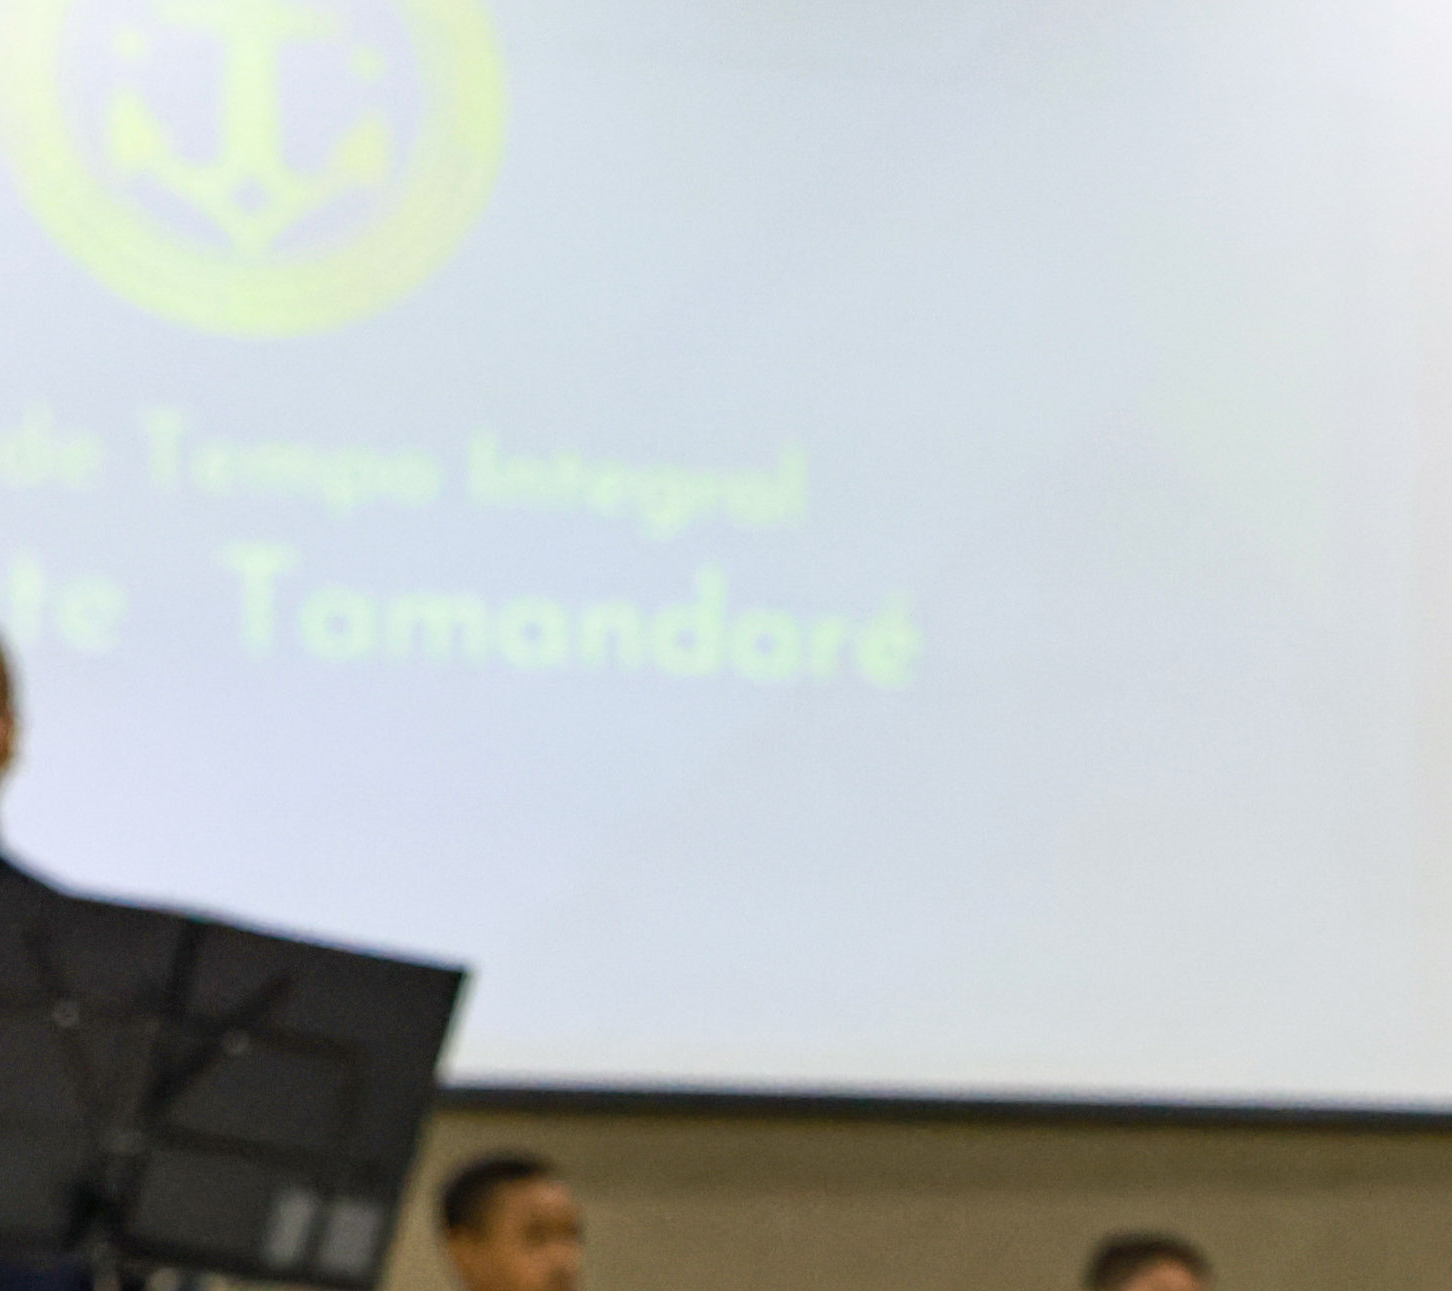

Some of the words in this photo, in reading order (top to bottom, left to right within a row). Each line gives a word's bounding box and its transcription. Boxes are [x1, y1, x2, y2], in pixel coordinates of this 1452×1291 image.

[139, 406, 439, 515] Tempo
[467, 431, 806, 540] Integral
[220, 538, 924, 688] Tamandaré
